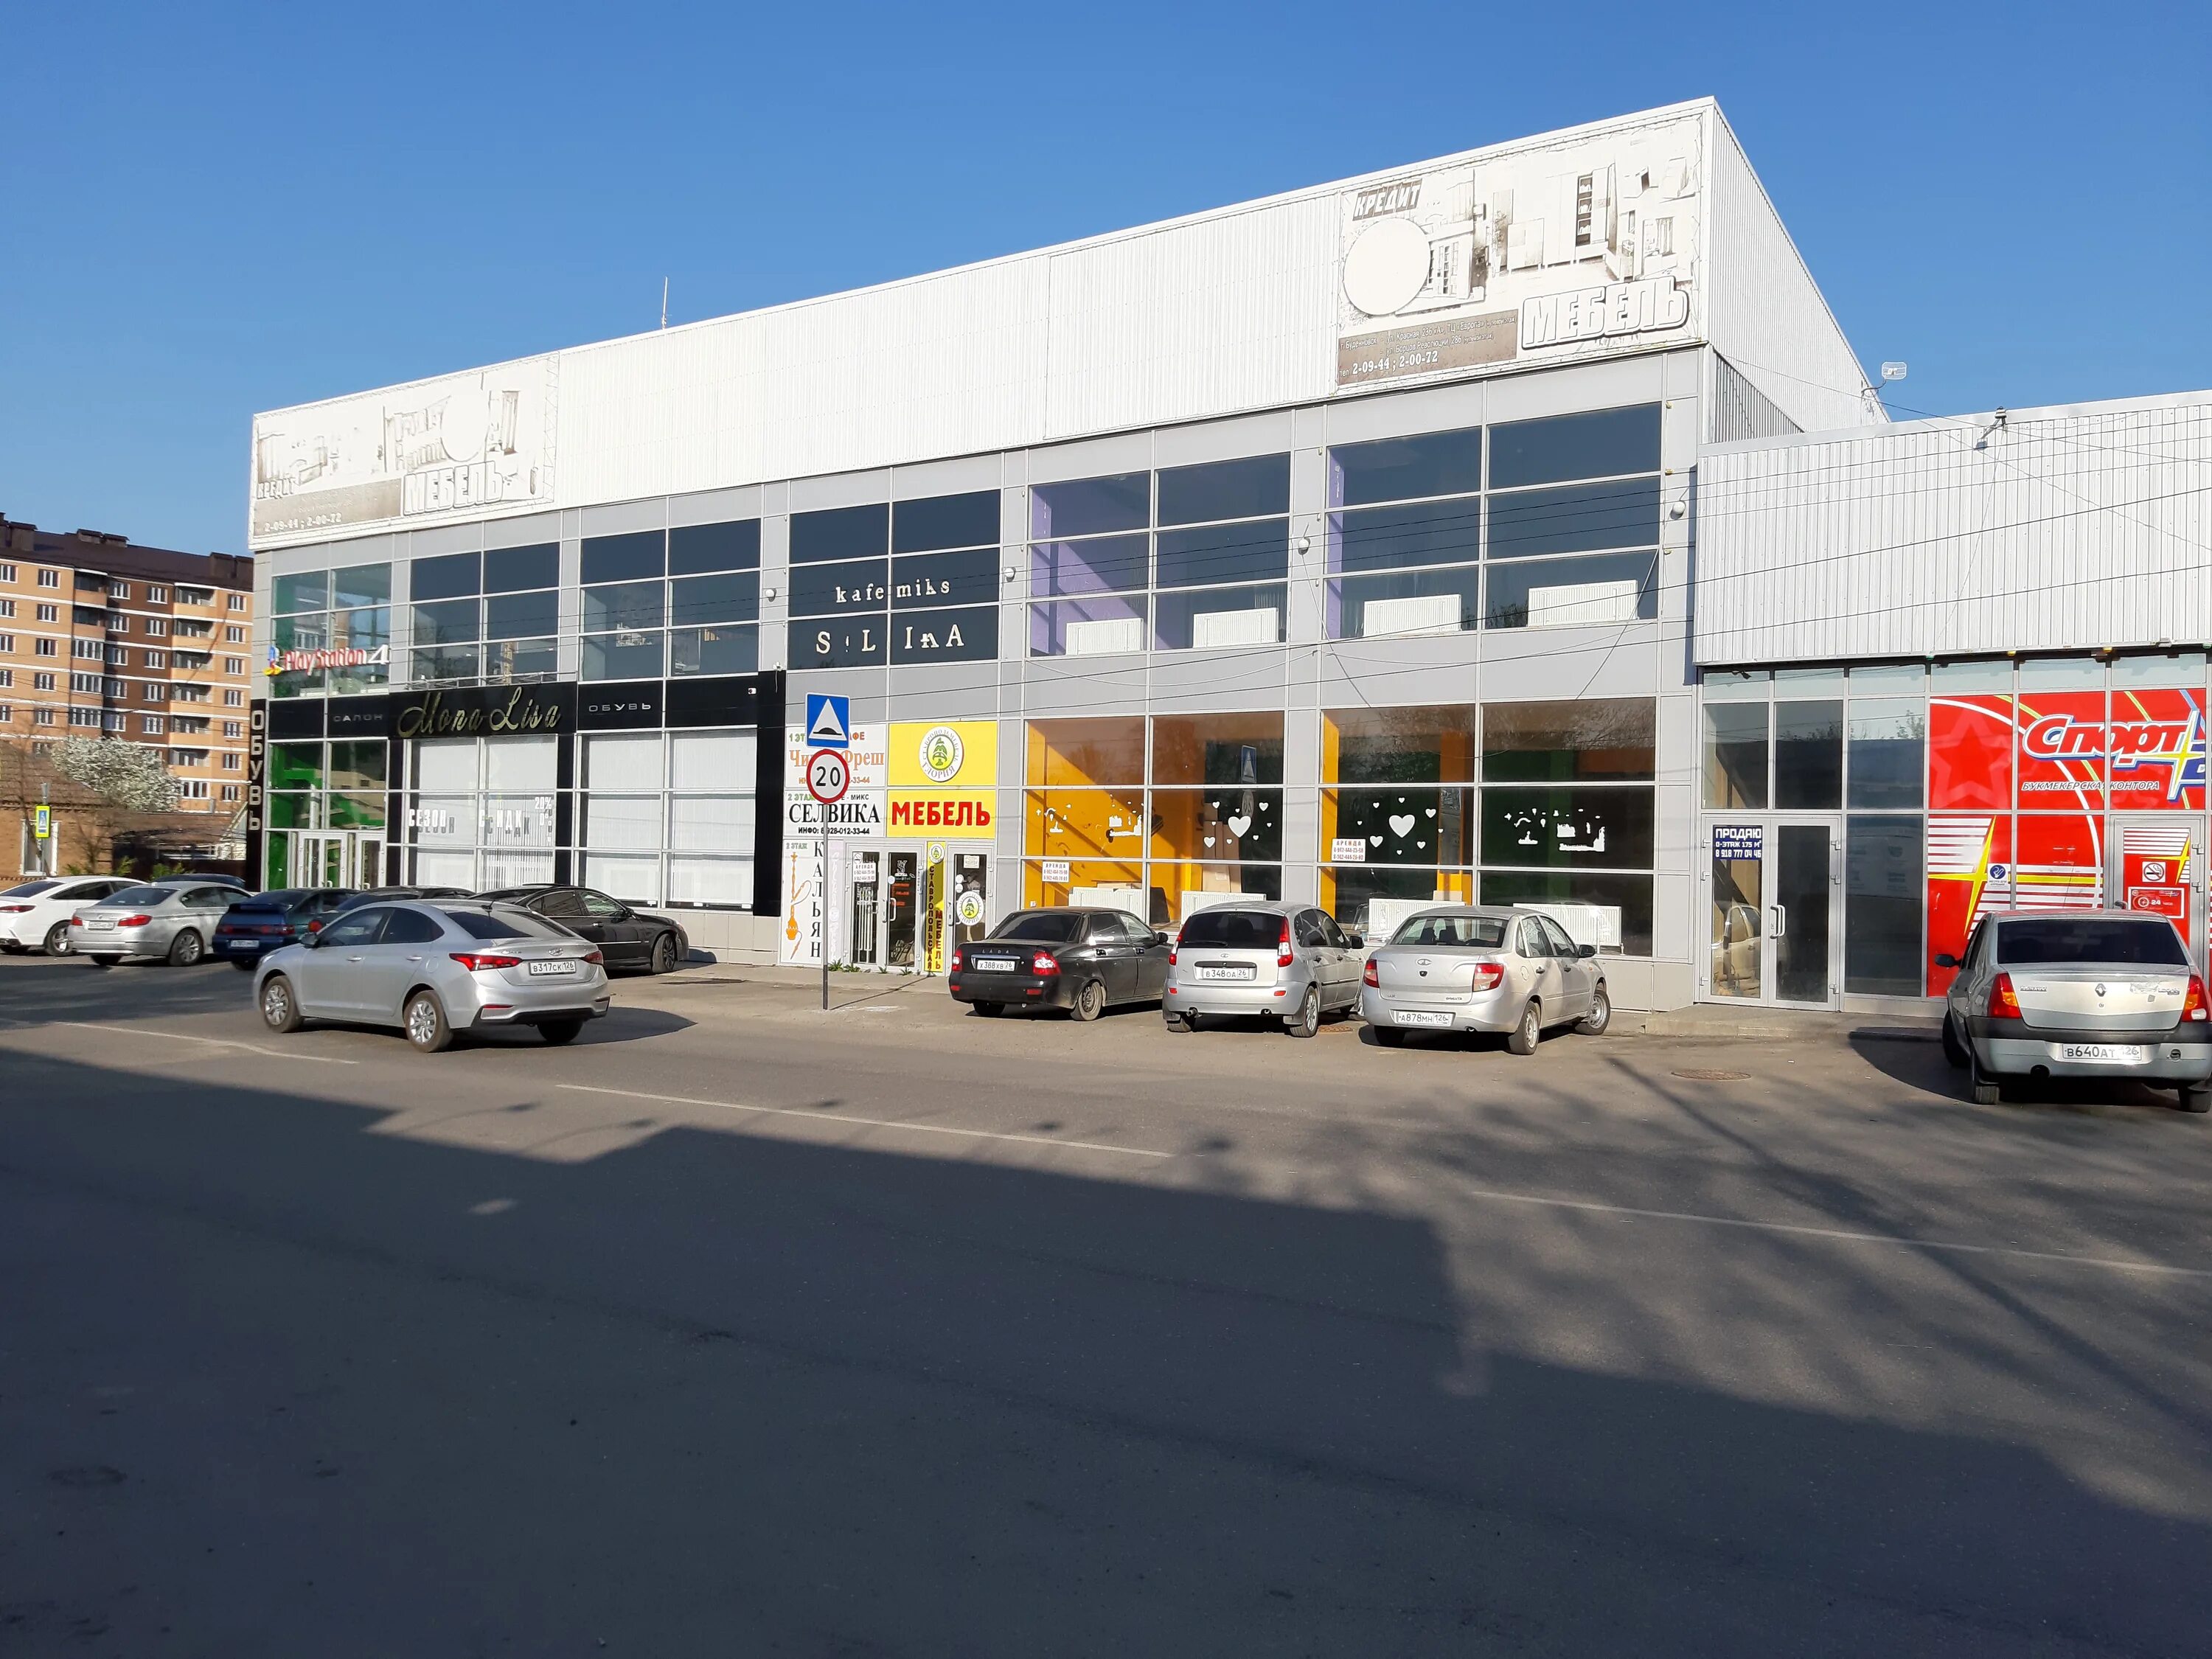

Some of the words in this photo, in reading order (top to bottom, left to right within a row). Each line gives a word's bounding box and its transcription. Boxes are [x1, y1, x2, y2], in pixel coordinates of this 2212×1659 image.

[1354, 184, 1422, 218] КРЕДИТ
[1523, 276, 1689, 349] МЕБЕЛЬ
[1352, 357, 1390, 374] 2-09-44
[1399, 350, 1439, 367] 2-00-72
[403, 461, 504, 516] МЕБЕЛЬ
[836, 583, 884, 603] kafe
[897, 578, 950, 598] miks
[284, 647, 367, 676] PlayStation
[367, 644, 390, 664] 4
[490, 686, 561, 731] Lisa
[588, 703, 651, 712] ОБУВЬ
[248, 710, 265, 831] ОБУВЬ
[816, 766, 841, 787] 20
[2110, 781, 2159, 791] КОНТОРА
[789, 803, 880, 824] СЕЛВИКА
[891, 801, 990, 827] МЕБЕЛЬ
[798, 827, 819, 835] ИНФО:
[1715, 828, 1761, 841] ПРОДАЮ
[1715, 849, 1719, 858] 8
[1721, 849, 1732, 858] 918
[1733, 849, 1743, 858] 777
[1744, 849, 1753, 858] 04
[1753, 849, 1761, 858] 46
[810, 841, 824, 958] КАЛЬЯН
[935, 910, 943, 970] МЕБЕЛЬ
[533, 963, 562, 972] В317СК
[1206, 970, 1237, 978] В348ОА
[1400, 1013, 1433, 1022] А878МН
[2067, 1046, 2115, 1057] В640АТ
